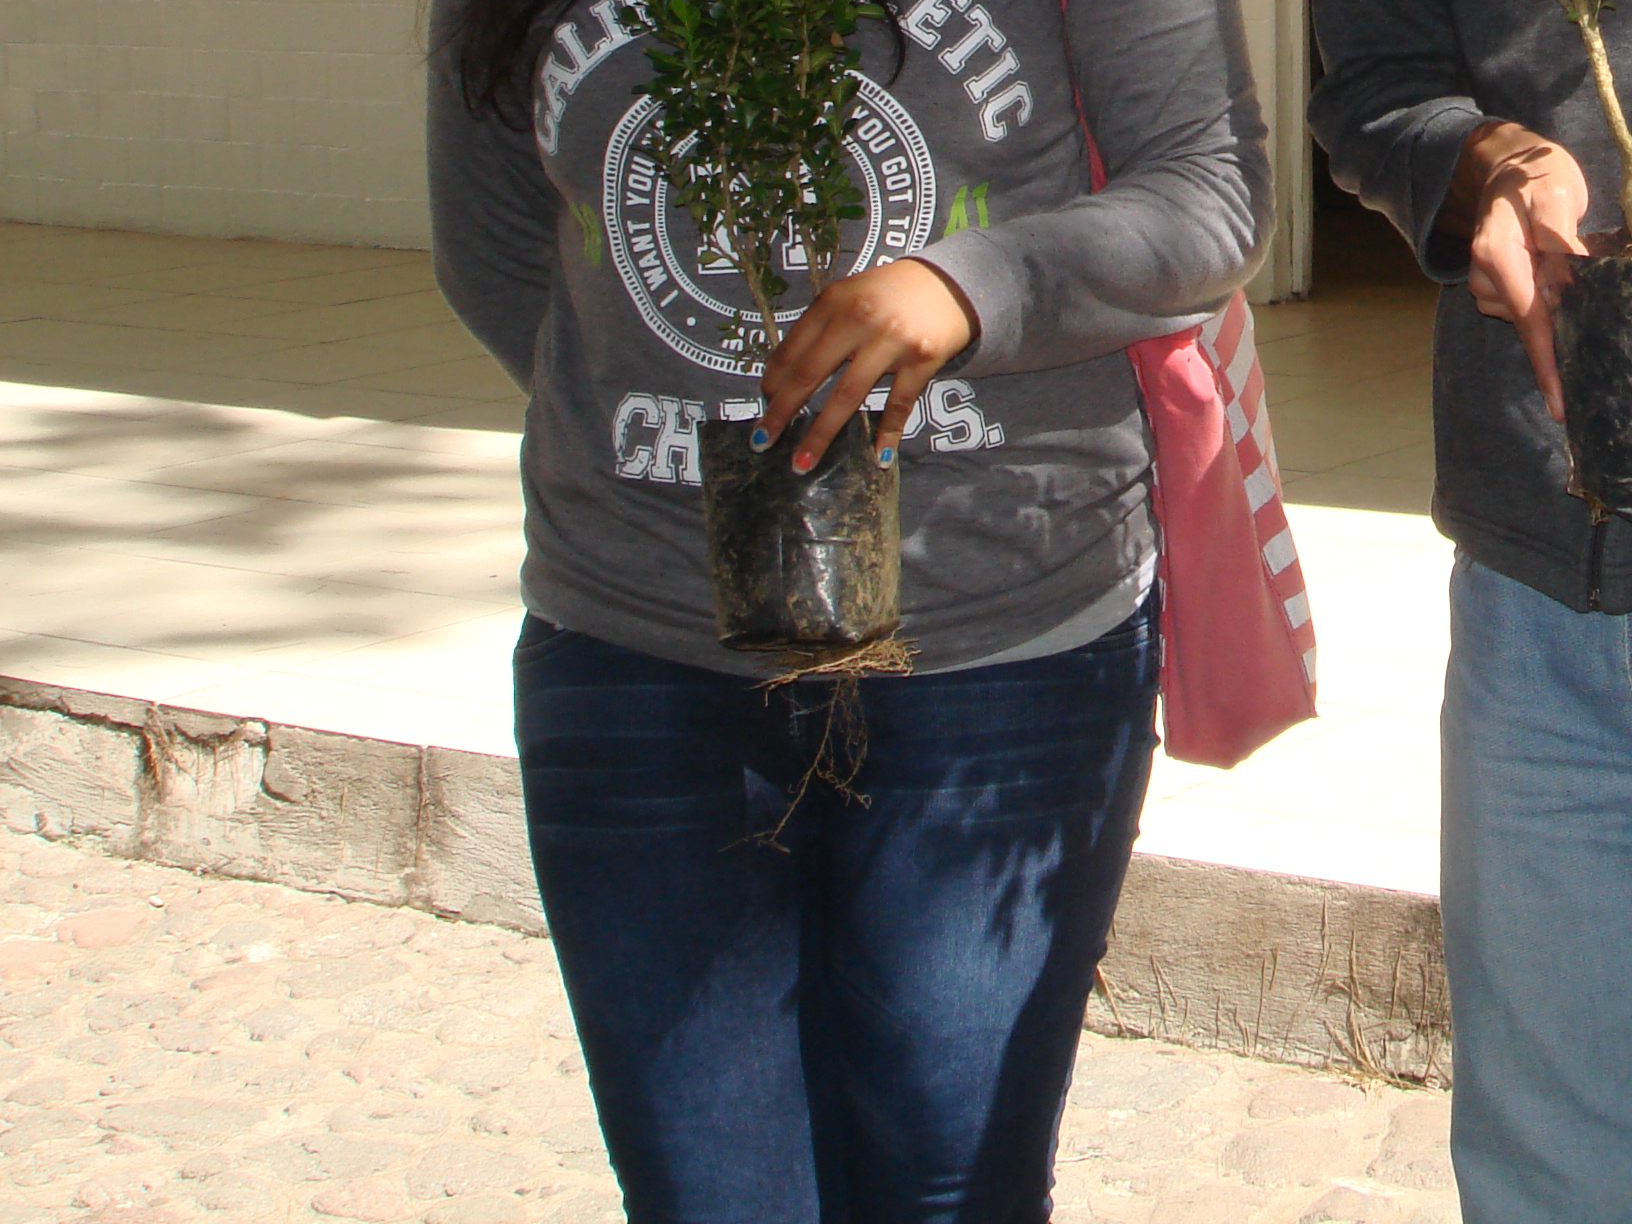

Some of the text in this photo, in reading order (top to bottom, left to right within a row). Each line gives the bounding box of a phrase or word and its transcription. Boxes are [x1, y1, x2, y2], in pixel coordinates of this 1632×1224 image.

[625, 155, 656, 206] YOU
[881, 155, 914, 203] GOT
[626, 220, 669, 292] WANT
[884, 215, 911, 249] TO
